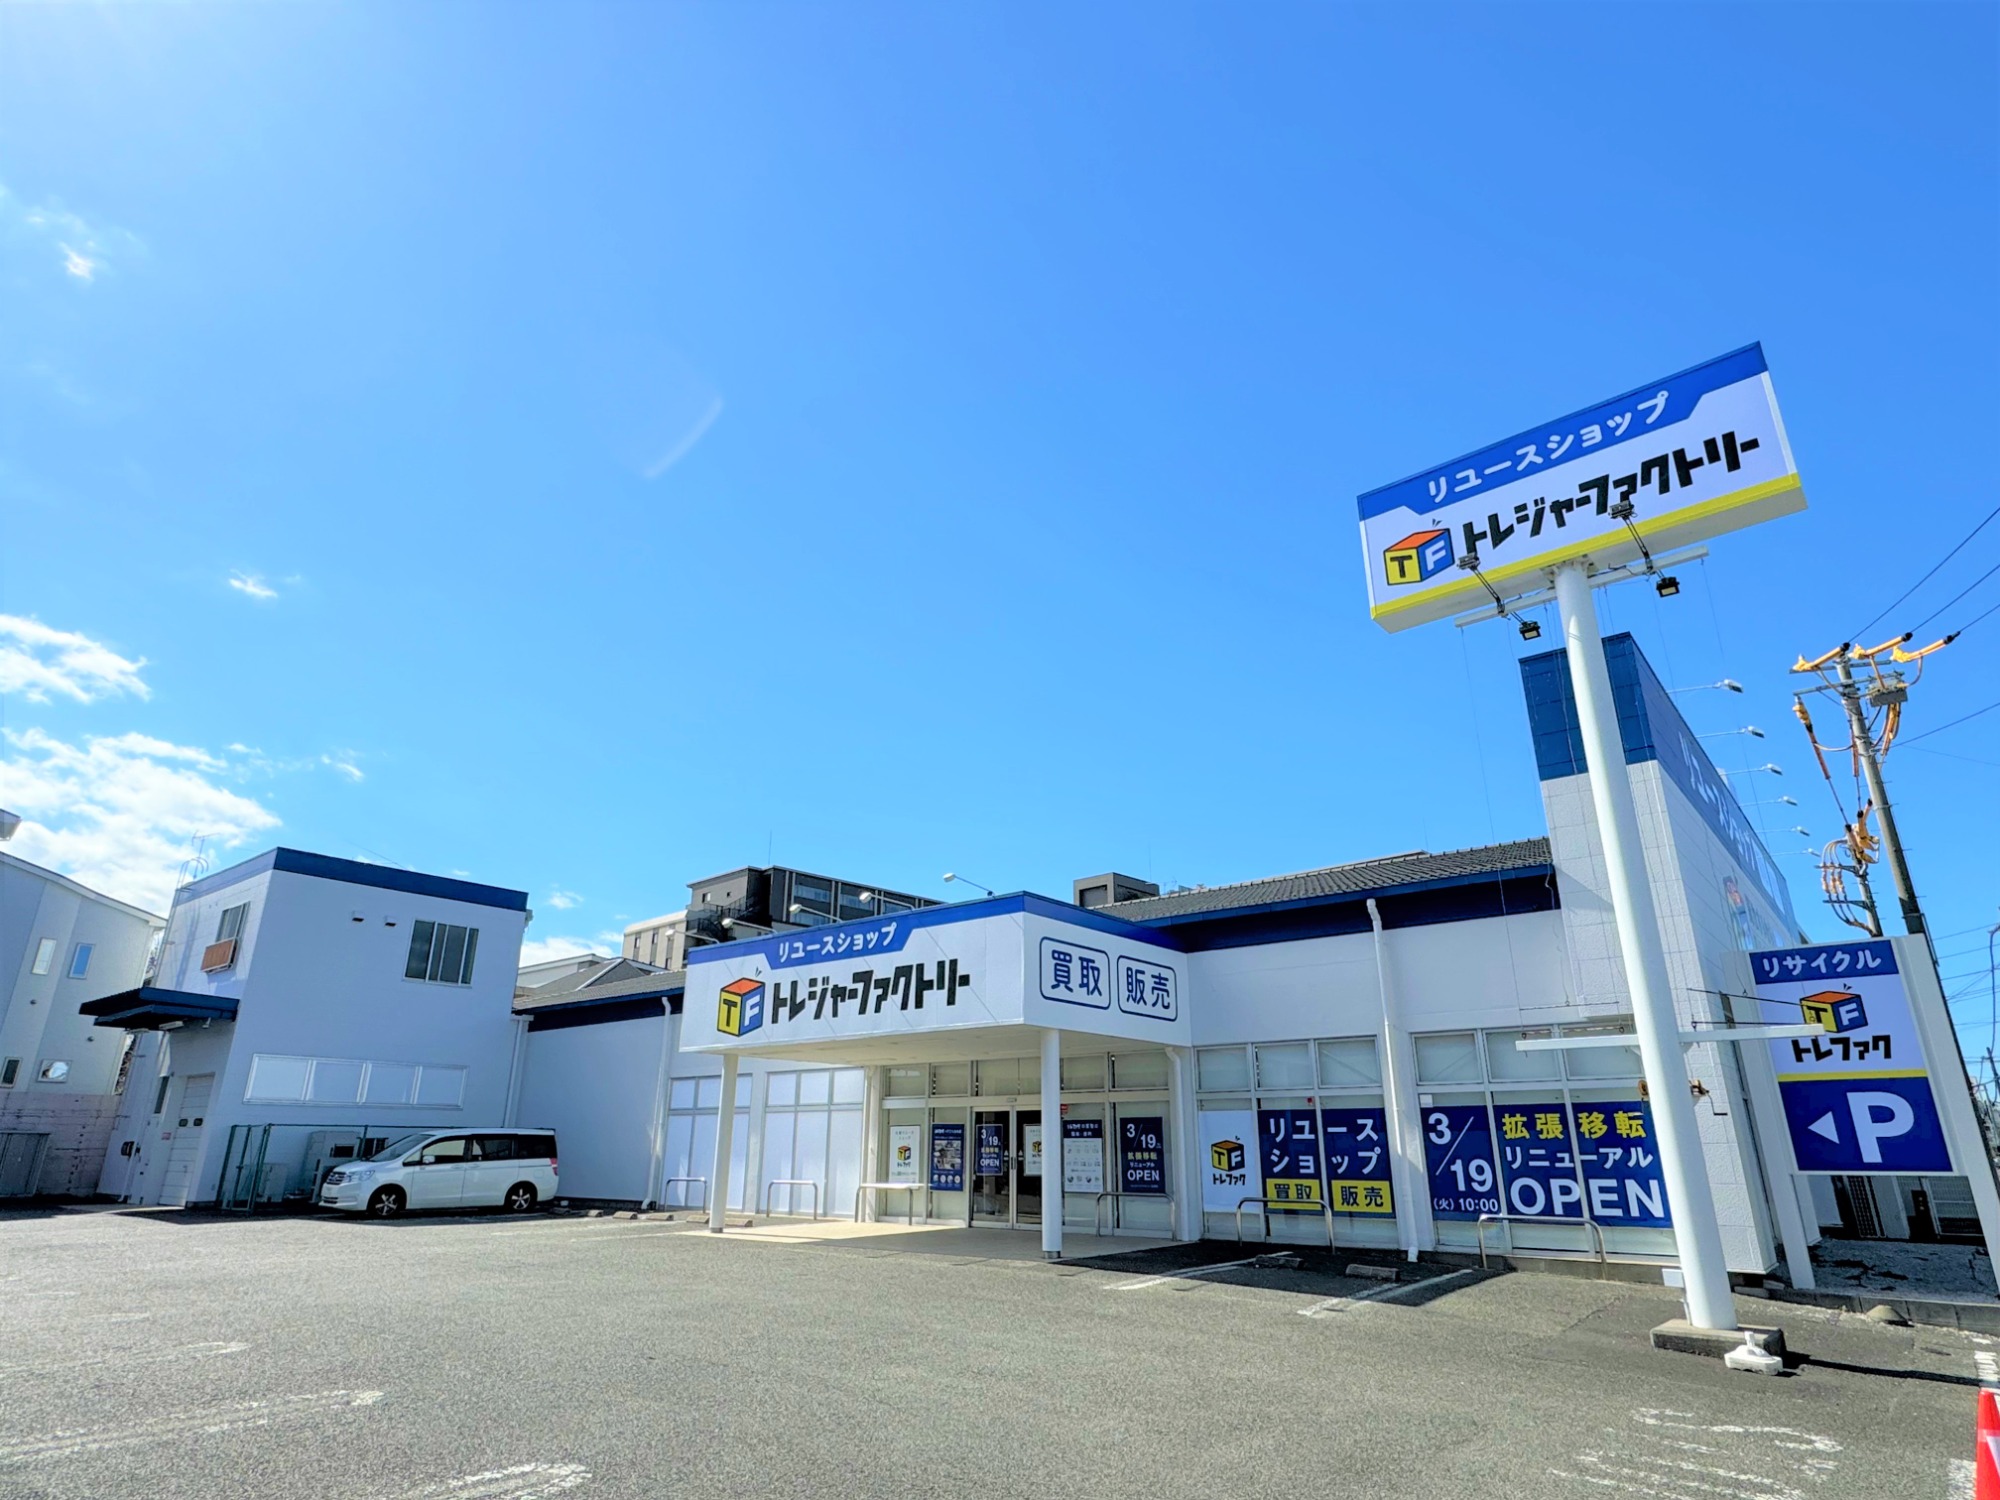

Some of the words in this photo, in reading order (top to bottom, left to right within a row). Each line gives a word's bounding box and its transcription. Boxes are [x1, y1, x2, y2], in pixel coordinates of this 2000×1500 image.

[1428, 390, 1670, 503] リユースショップ
[1462, 431, 1760, 555] トレジャーファクトリー
[778, 921, 898, 963] リユースショップ
[1050, 950, 1104, 997] 買取
[1762, 949, 1881, 978] リサイクル
[771, 958, 971, 1025] トレジャーファクトリー
[1126, 966, 1172, 1010] 販売
[1791, 1034, 1892, 1063] トレファク
[1269, 1118, 1379, 1143] リユース
[1502, 1111, 1647, 1139] 拡張移転
[1846, 1091, 1915, 1163] P
[980, 1158, 999, 1167] OPEN
[1270, 1146, 1382, 1175] ショップ
[1505, 1146, 1653, 1170] リニューアル
[1127, 1170, 1160, 1182] OPEN
[1212, 1173, 1246, 1186] トレファク
[1340, 1186, 1384, 1208] 販売
[1458, 1198, 1499, 1213] 10:00
[1509, 1176, 1665, 1219] OPEN
